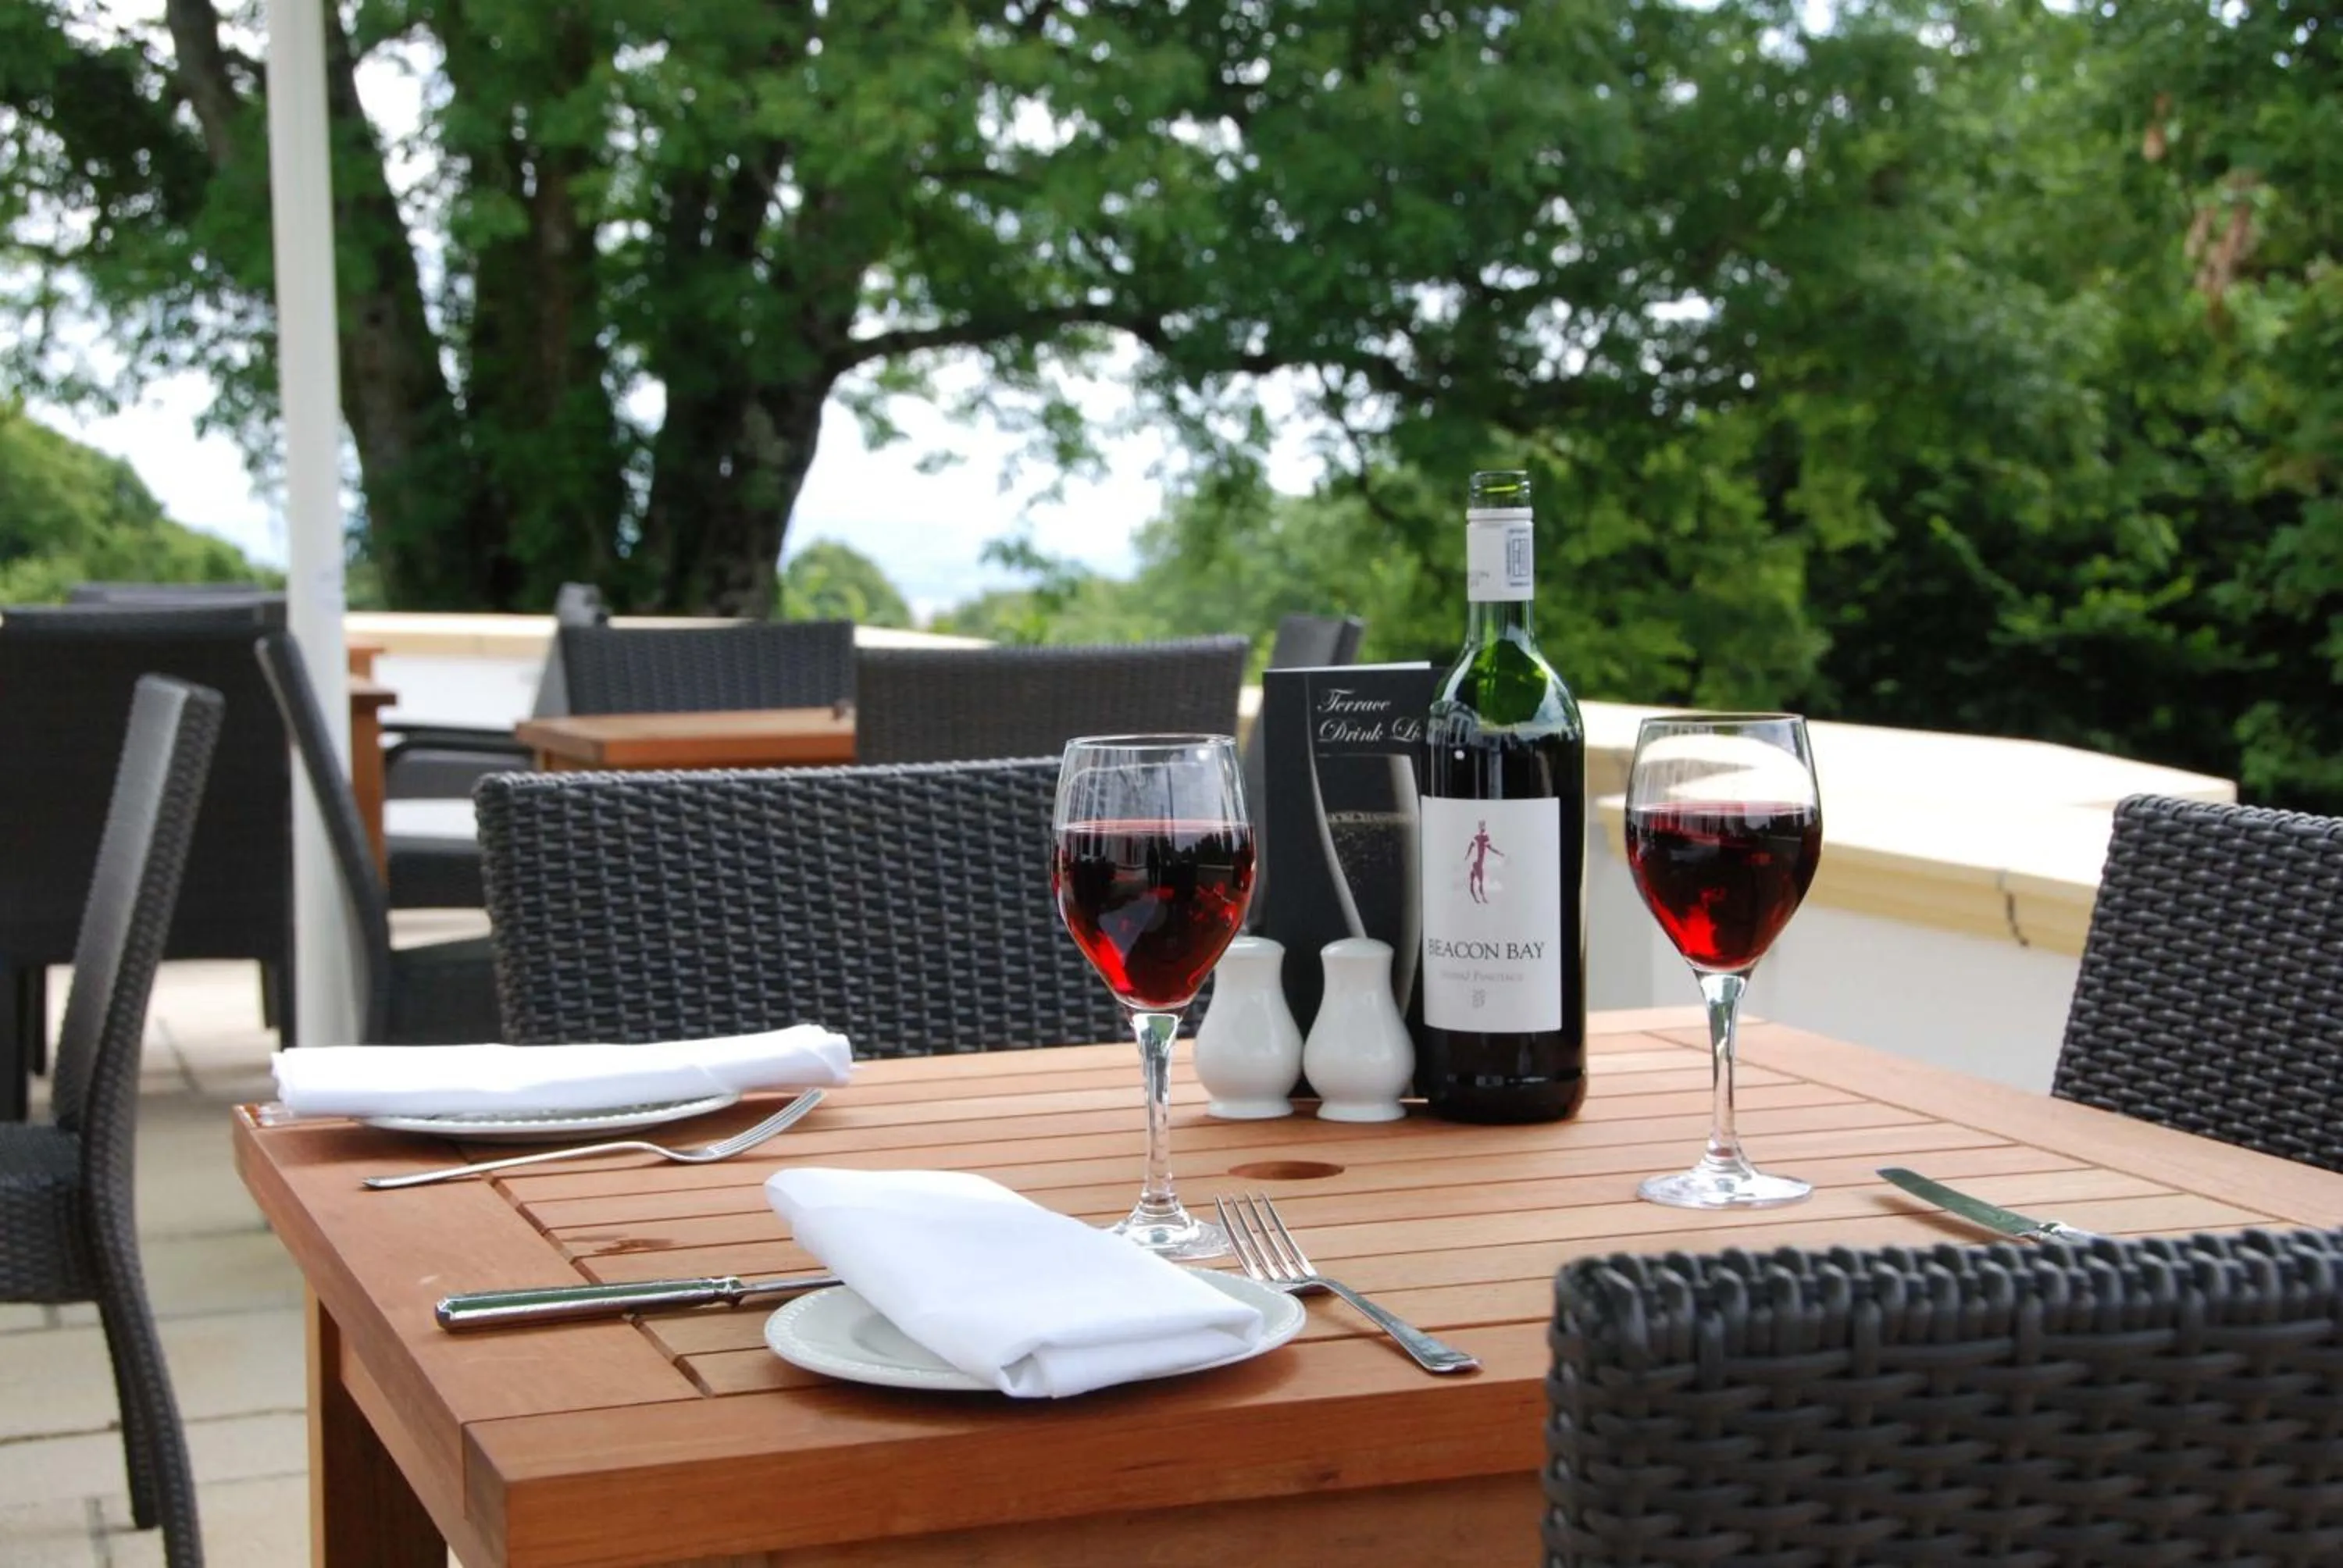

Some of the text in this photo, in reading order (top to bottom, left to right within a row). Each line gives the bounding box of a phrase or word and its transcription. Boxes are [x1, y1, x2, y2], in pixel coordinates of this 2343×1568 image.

[1316, 688, 1392, 712] Terrace
[1318, 716, 1422, 743] Drink Li
[1427, 938, 1545, 960] BEACON BAY
